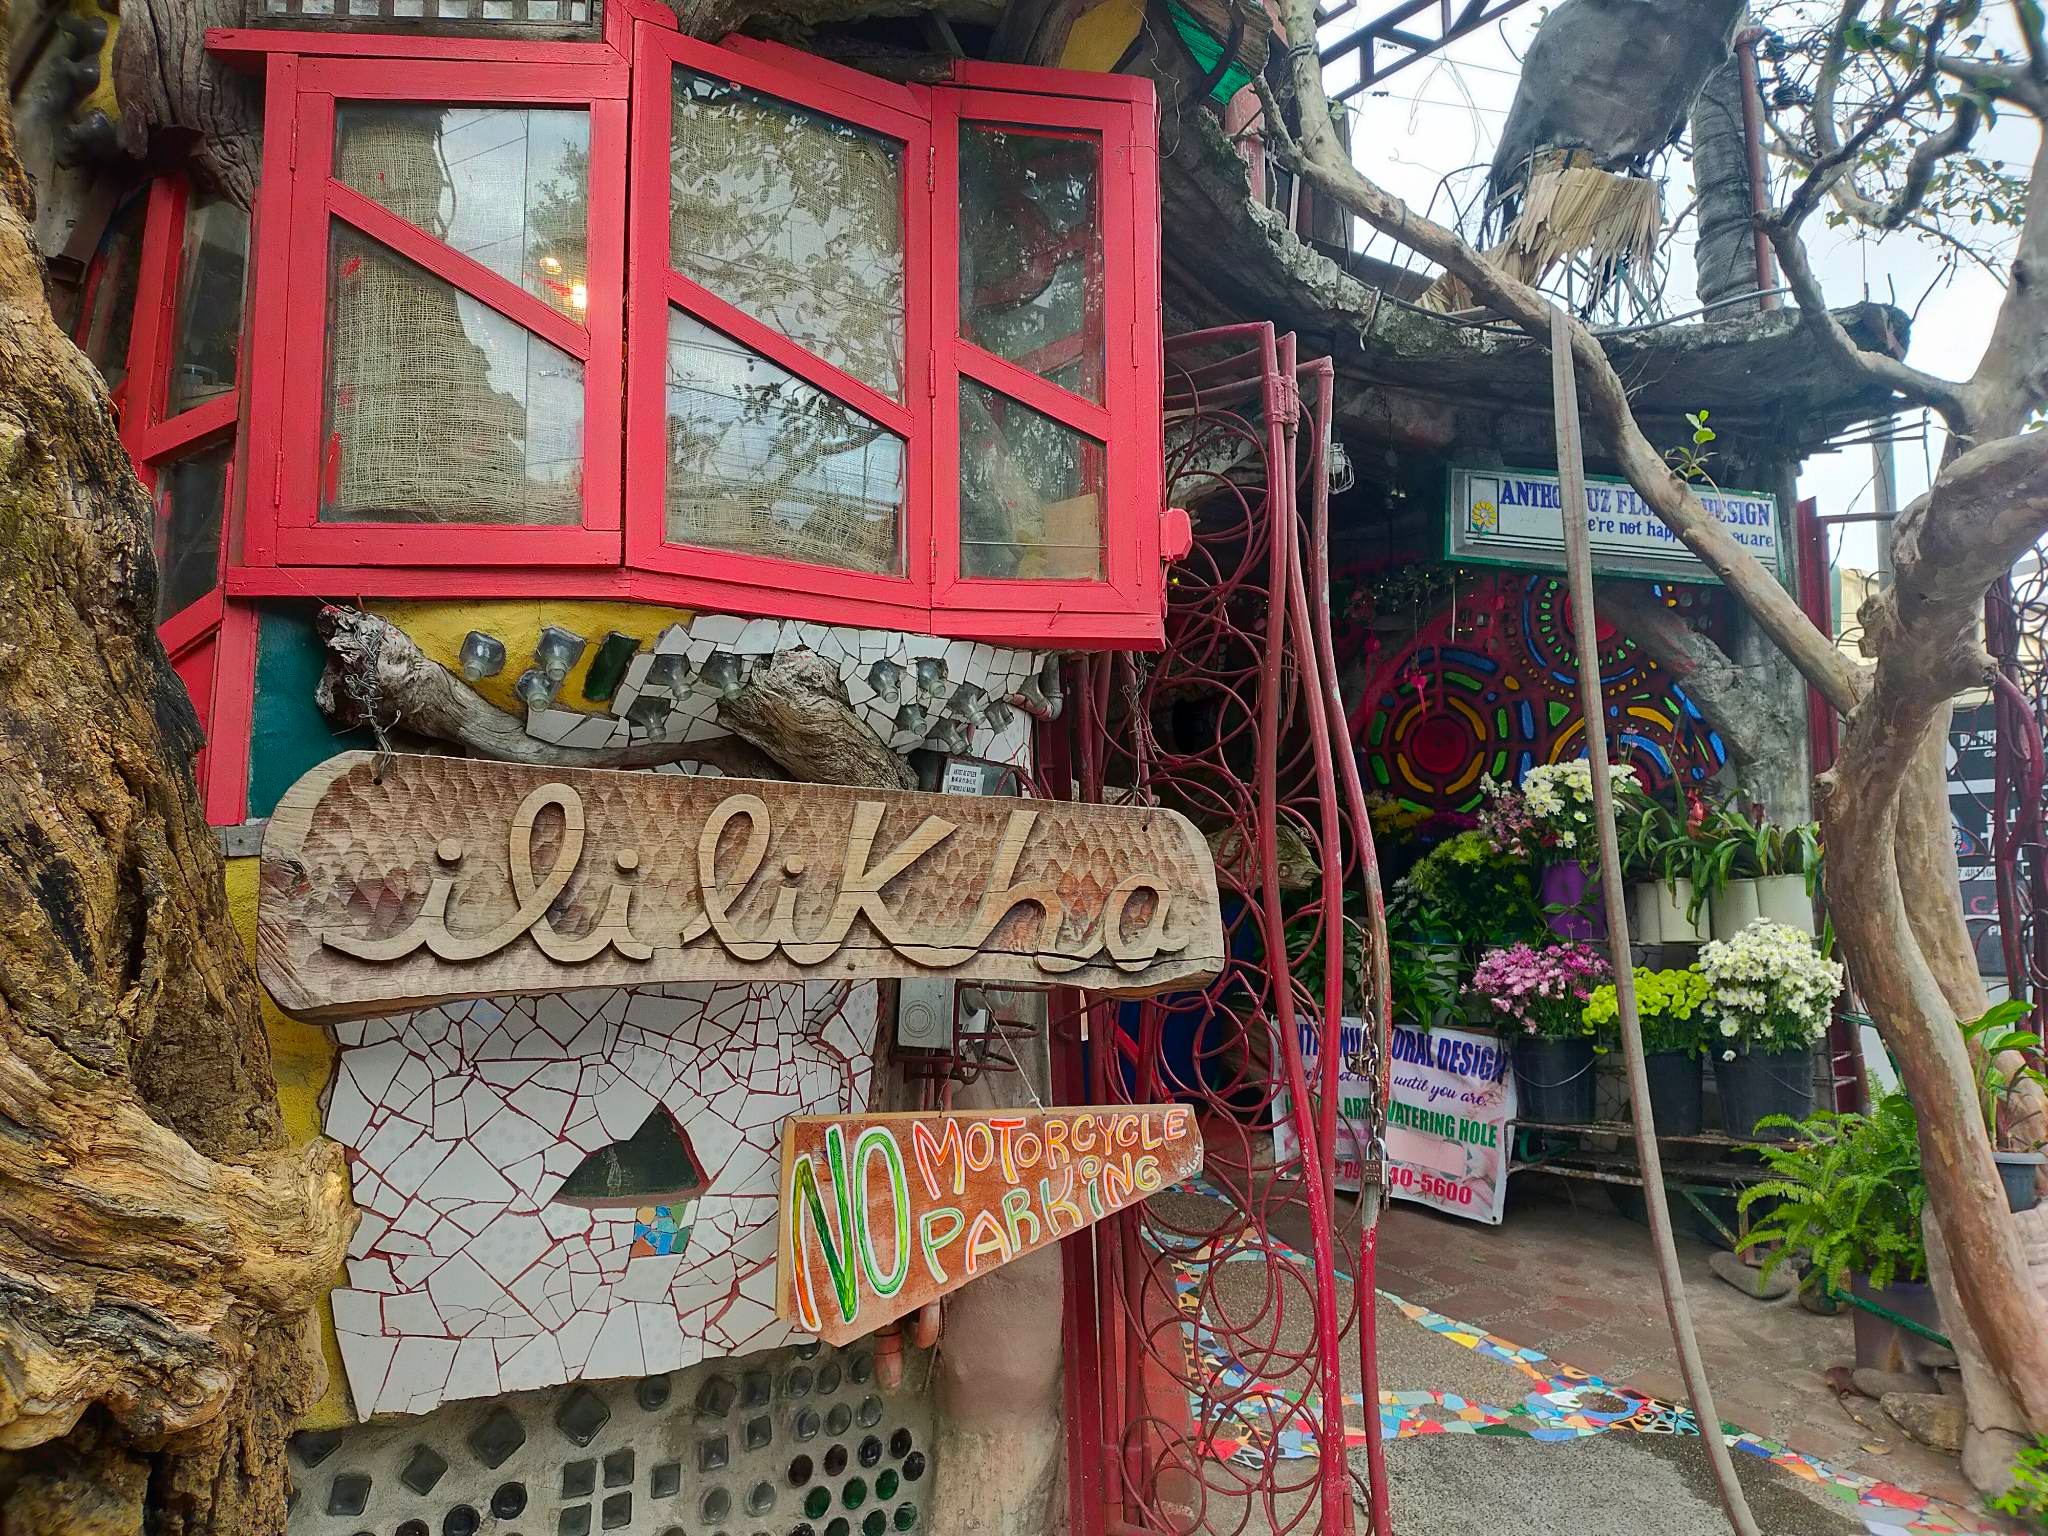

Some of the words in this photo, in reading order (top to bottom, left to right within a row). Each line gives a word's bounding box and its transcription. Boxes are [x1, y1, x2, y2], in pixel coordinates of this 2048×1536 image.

[1700, 498, 1770, 526] DESIGN
[1588, 516, 1615, 533] e're
[1620, 521, 1642, 535] not
[1732, 531, 1749, 545] ou
[1394, 1073, 1428, 1092] until
[1428, 1082, 1457, 1102] you
[1458, 1118, 1498, 1148] HOLE
[789, 1123, 910, 1332] NO
[912, 1108, 1188, 1200] MOTORCYCLE
